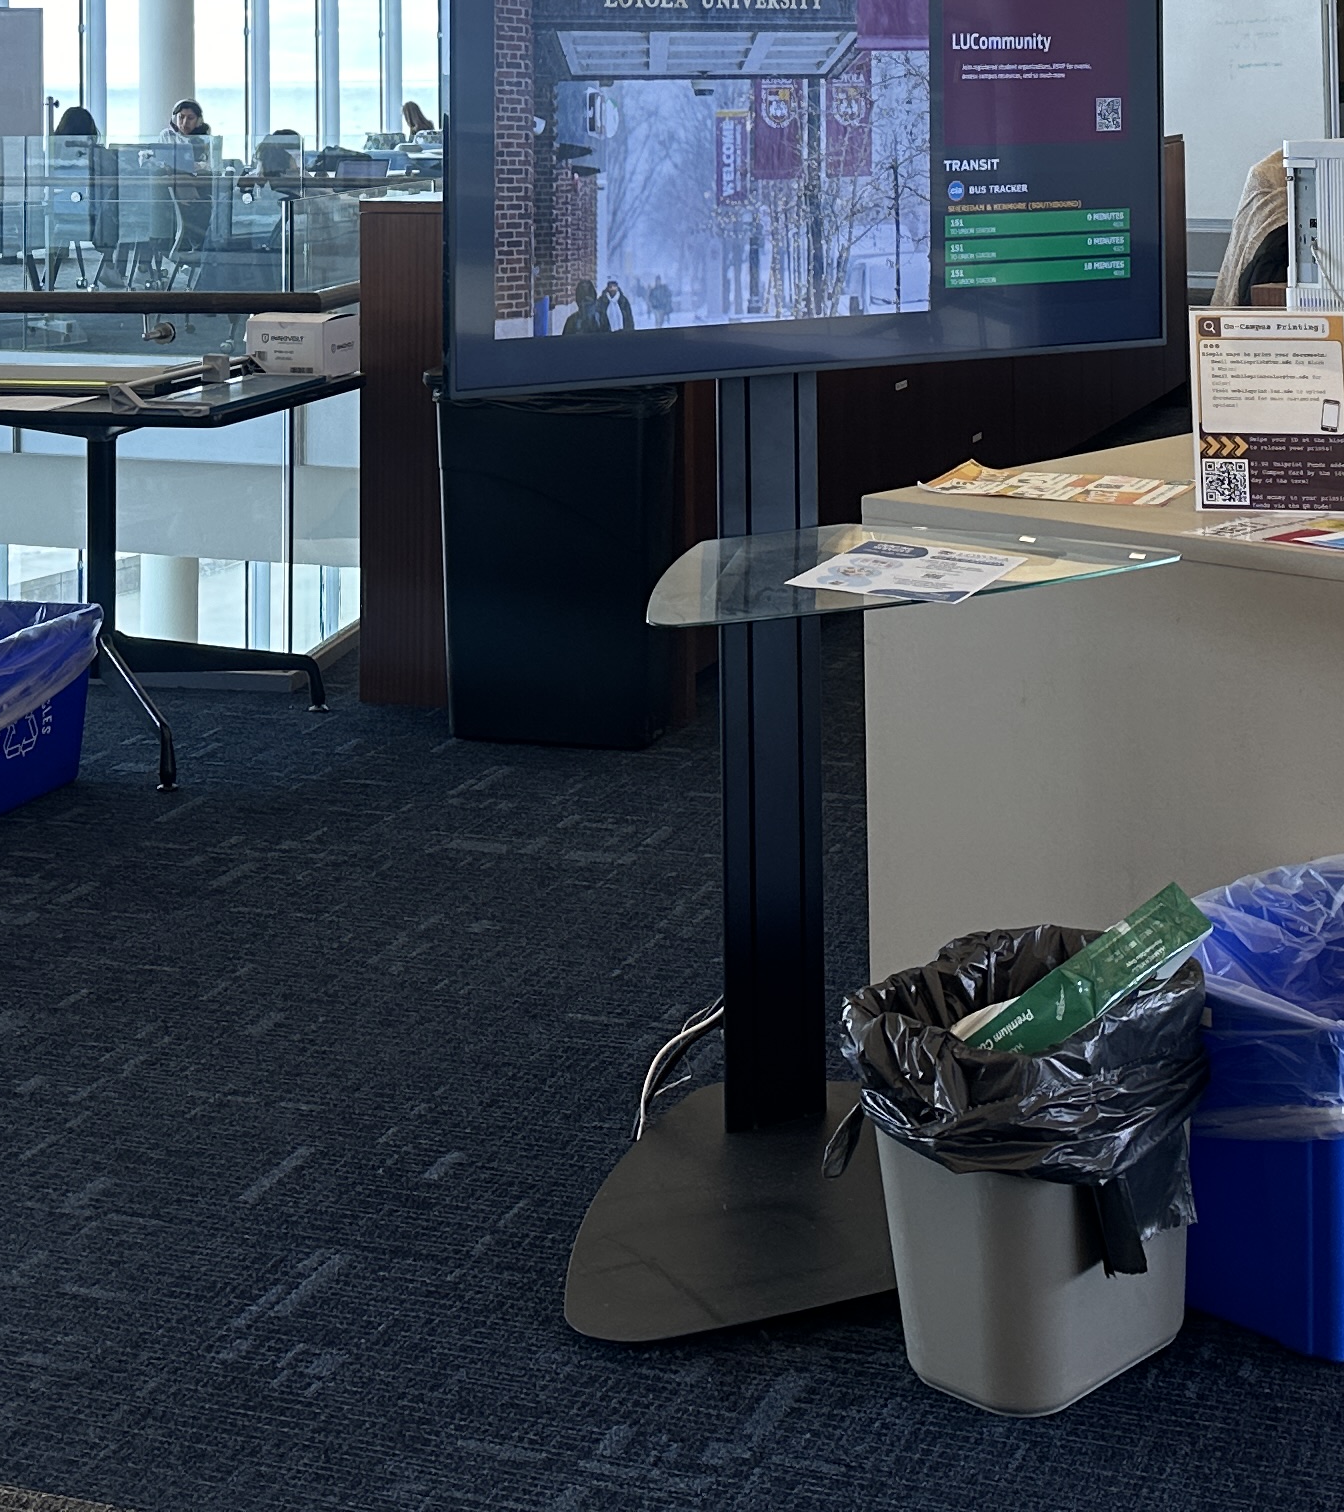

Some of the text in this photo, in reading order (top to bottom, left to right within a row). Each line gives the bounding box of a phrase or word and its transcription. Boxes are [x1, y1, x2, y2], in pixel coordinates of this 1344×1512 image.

[952, 33, 1051, 52] LUCommunity
[944, 159, 999, 172] TRANSIT
[968, 186, 987, 195] BUS
[989, 184, 1029, 194] TRACKER
[1276, 323, 1319, 332] Printing
[994, 1008, 1035, 1043] Premium
